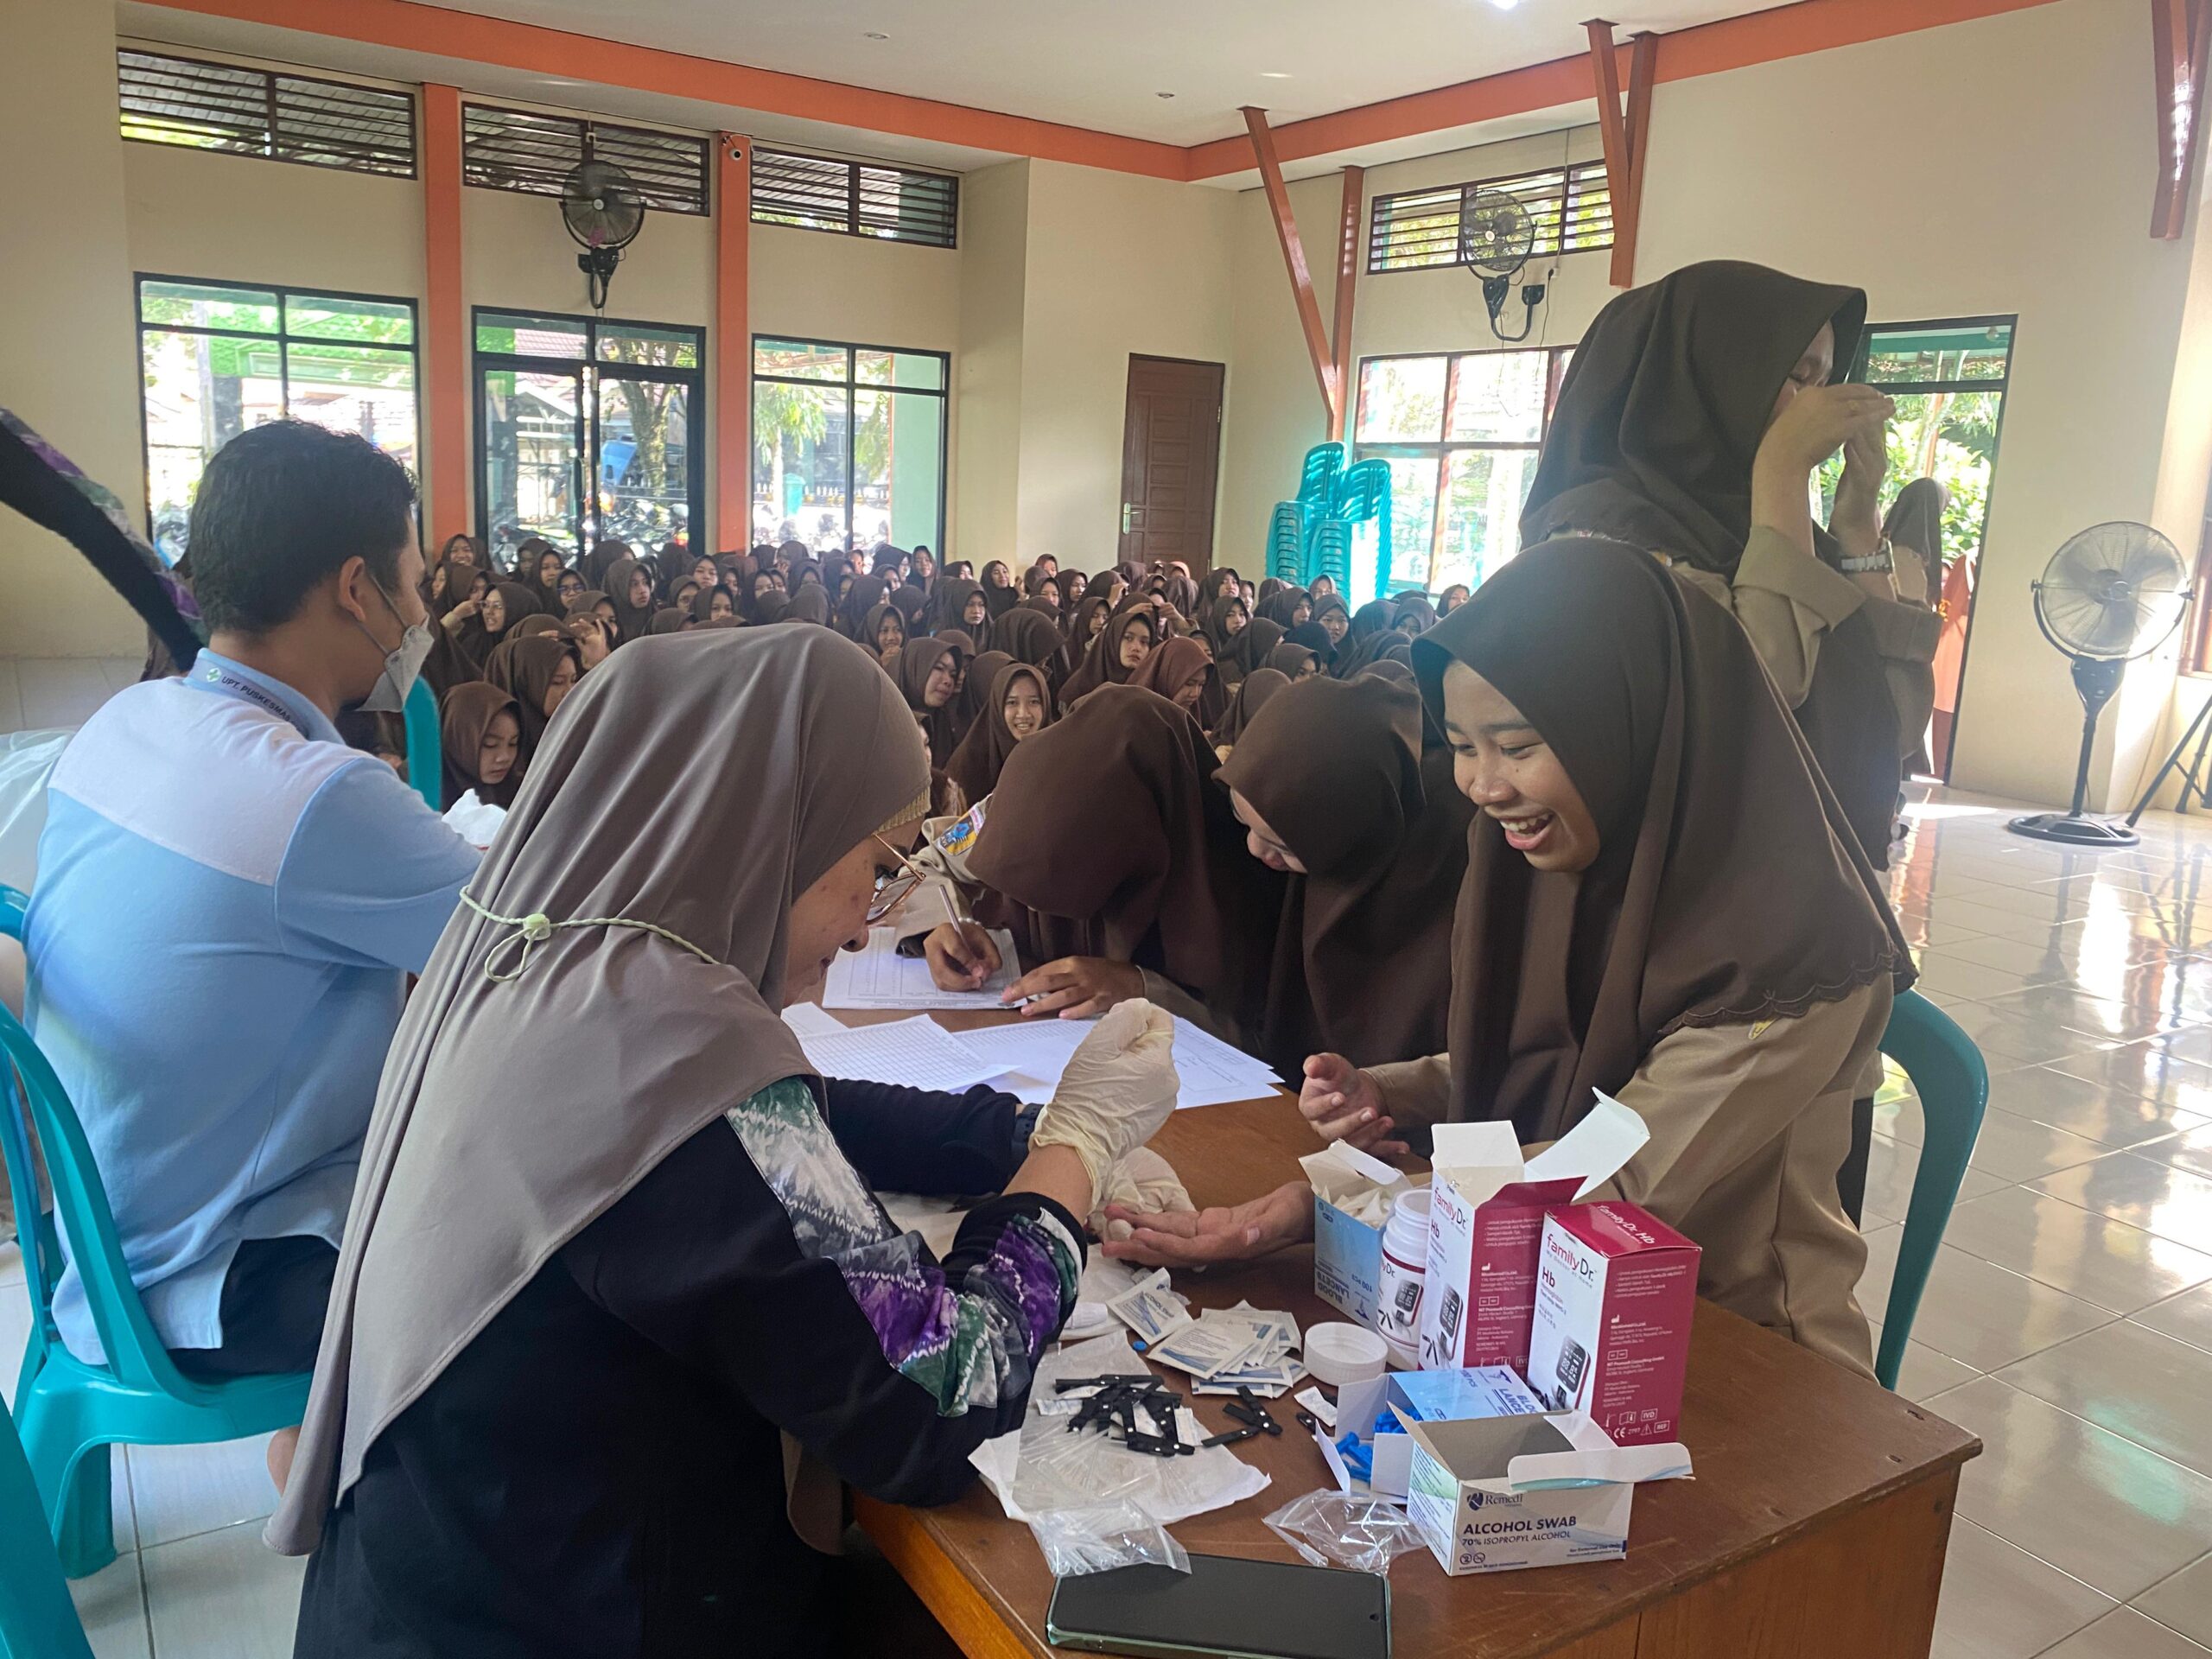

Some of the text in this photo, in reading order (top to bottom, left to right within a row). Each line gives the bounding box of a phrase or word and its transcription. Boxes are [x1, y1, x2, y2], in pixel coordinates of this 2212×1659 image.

[1430, 1218, 1440, 1239] Hb
[1636, 1231, 1656, 1244] Hb
[1317, 1271, 1350, 1300] LANCETS
[1541, 1266, 1556, 1287] Hb
[1317, 1282, 1343, 1305] BLOOD
[1361, 1280, 1373, 1293] 100
[1499, 1388, 1524, 1415] LANCE
[1516, 1395, 1538, 1414] BLO
[1643, 1410, 1656, 1420] IVD
[1484, 1493, 1523, 1505] Remedi
[1463, 1516, 1577, 1535] ALCOHOL SWAB
[1461, 1530, 1571, 1547] 70% ISOPROPYL ALCOHOL
